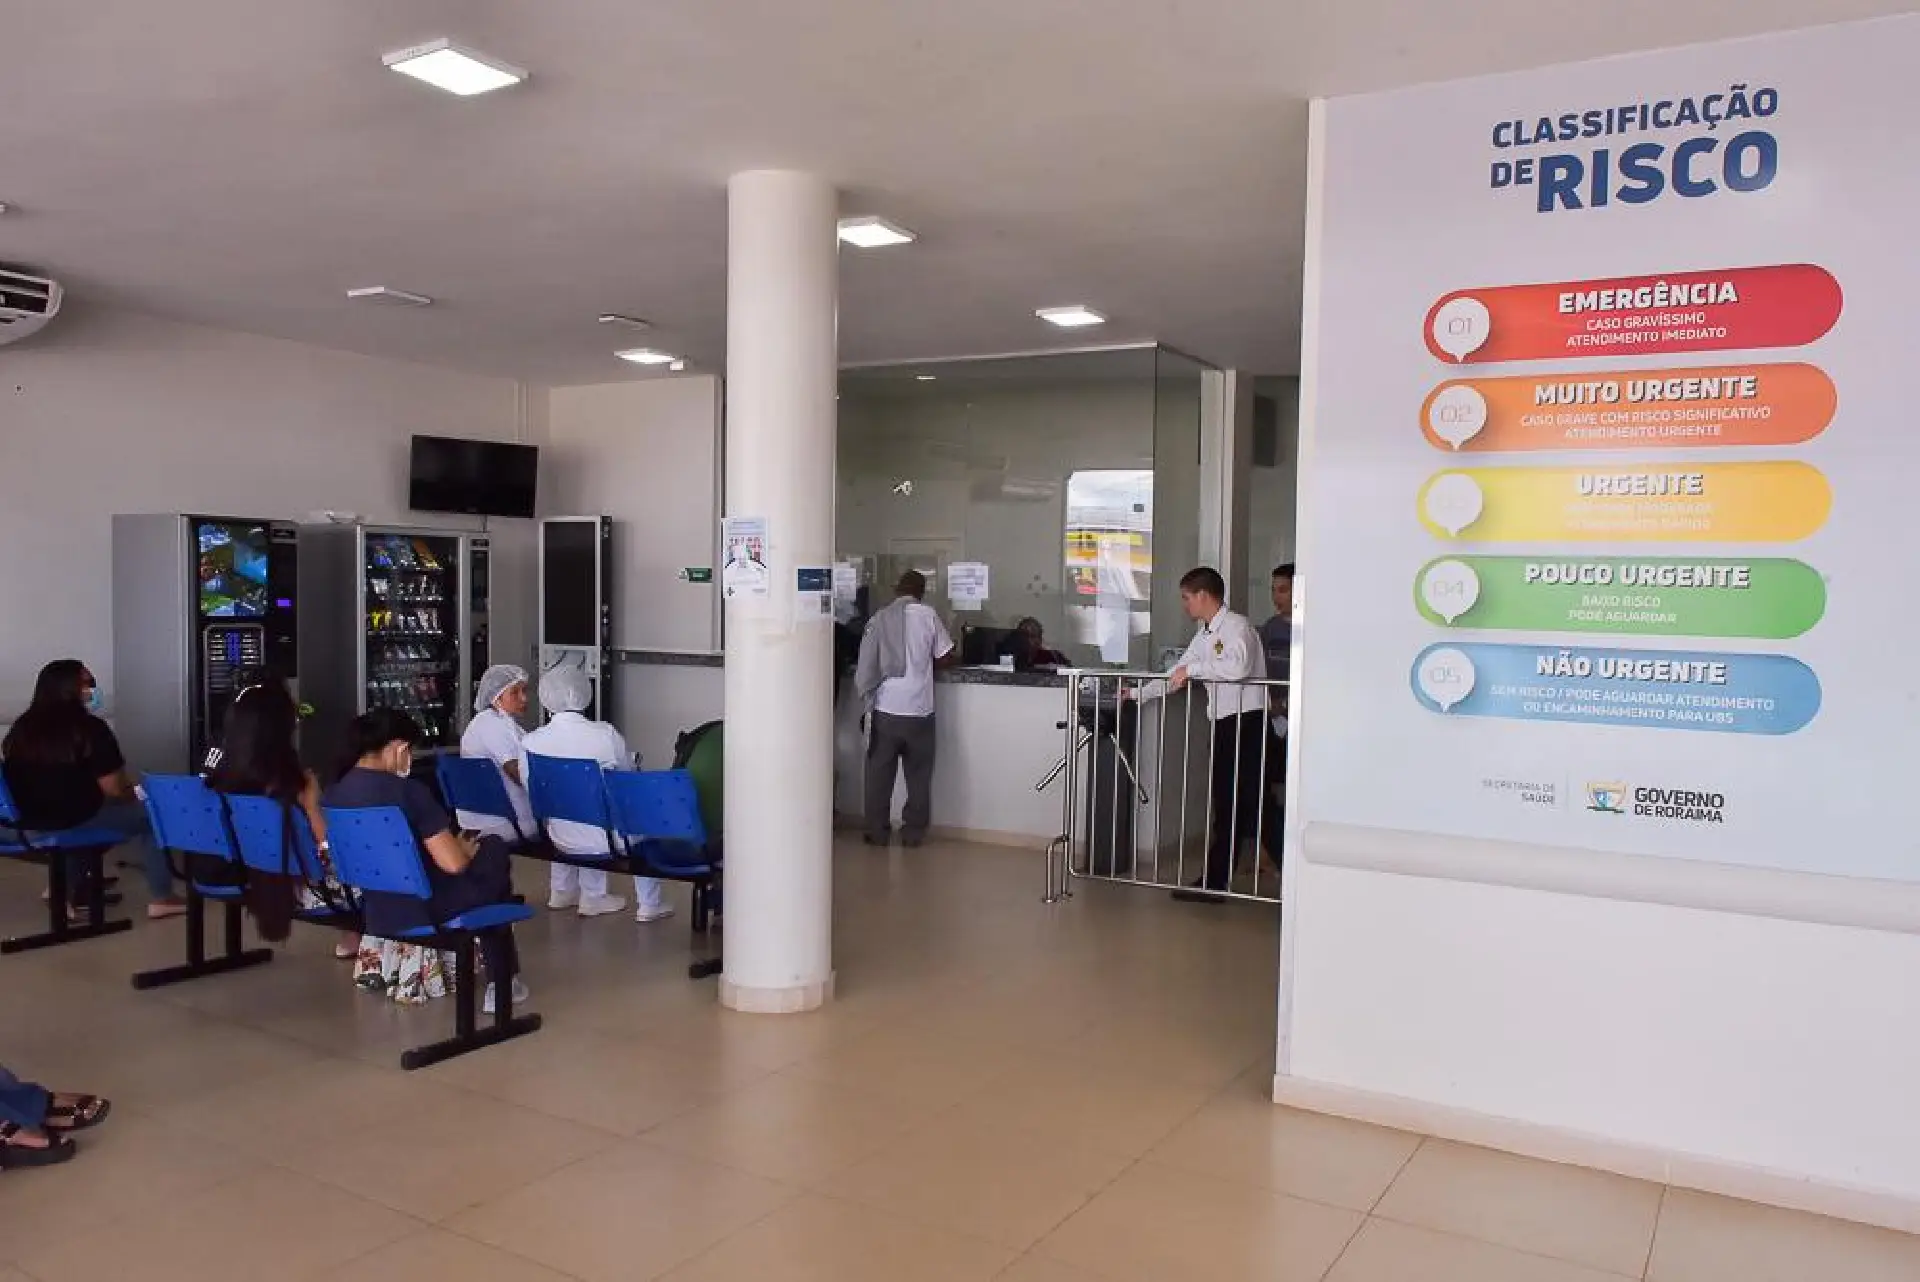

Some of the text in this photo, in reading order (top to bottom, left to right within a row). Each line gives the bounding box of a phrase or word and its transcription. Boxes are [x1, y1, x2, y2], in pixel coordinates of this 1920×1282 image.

[1492, 84, 1778, 148] CLASSIFICAÇÃO
[1490, 131, 1778, 213] DE RISCO
[1559, 281, 1739, 314] EMERGÊNCIA
[1586, 312, 1706, 331] CASO GRAVÍSSIMO
[1566, 327, 1727, 347] ATENDIMENTO IMEDIATO
[1535, 376, 1759, 406] MUITO URGENTE
[1600, 411, 1629, 424] COM
[1632, 410, 1669, 423] RISCO
[1671, 405, 1771, 422] SIGNIFICATIVO
[1659, 423, 1722, 437] URGENTE
[1577, 474, 1704, 496] URGENTE
[1525, 564, 1751, 588] POUCO URGENTE
[1622, 595, 1661, 607] RISCO
[1536, 650, 1727, 684] NÃO URGENTE
[1520, 686, 1556, 698] RISCO
[1566, 688, 1601, 700] PODE
[1602, 690, 1674, 706] AGUARDAR
[1676, 694, 1775, 711] ATENDIMENTO
[1543, 702, 1665, 719] ENCAMINHAMENTO
[1668, 709, 1704, 722] PARA
[1706, 711, 1734, 724] UBS
[1634, 787, 1725, 808] GOVERNO
[1634, 803, 1723, 823] DE RORAIMA
